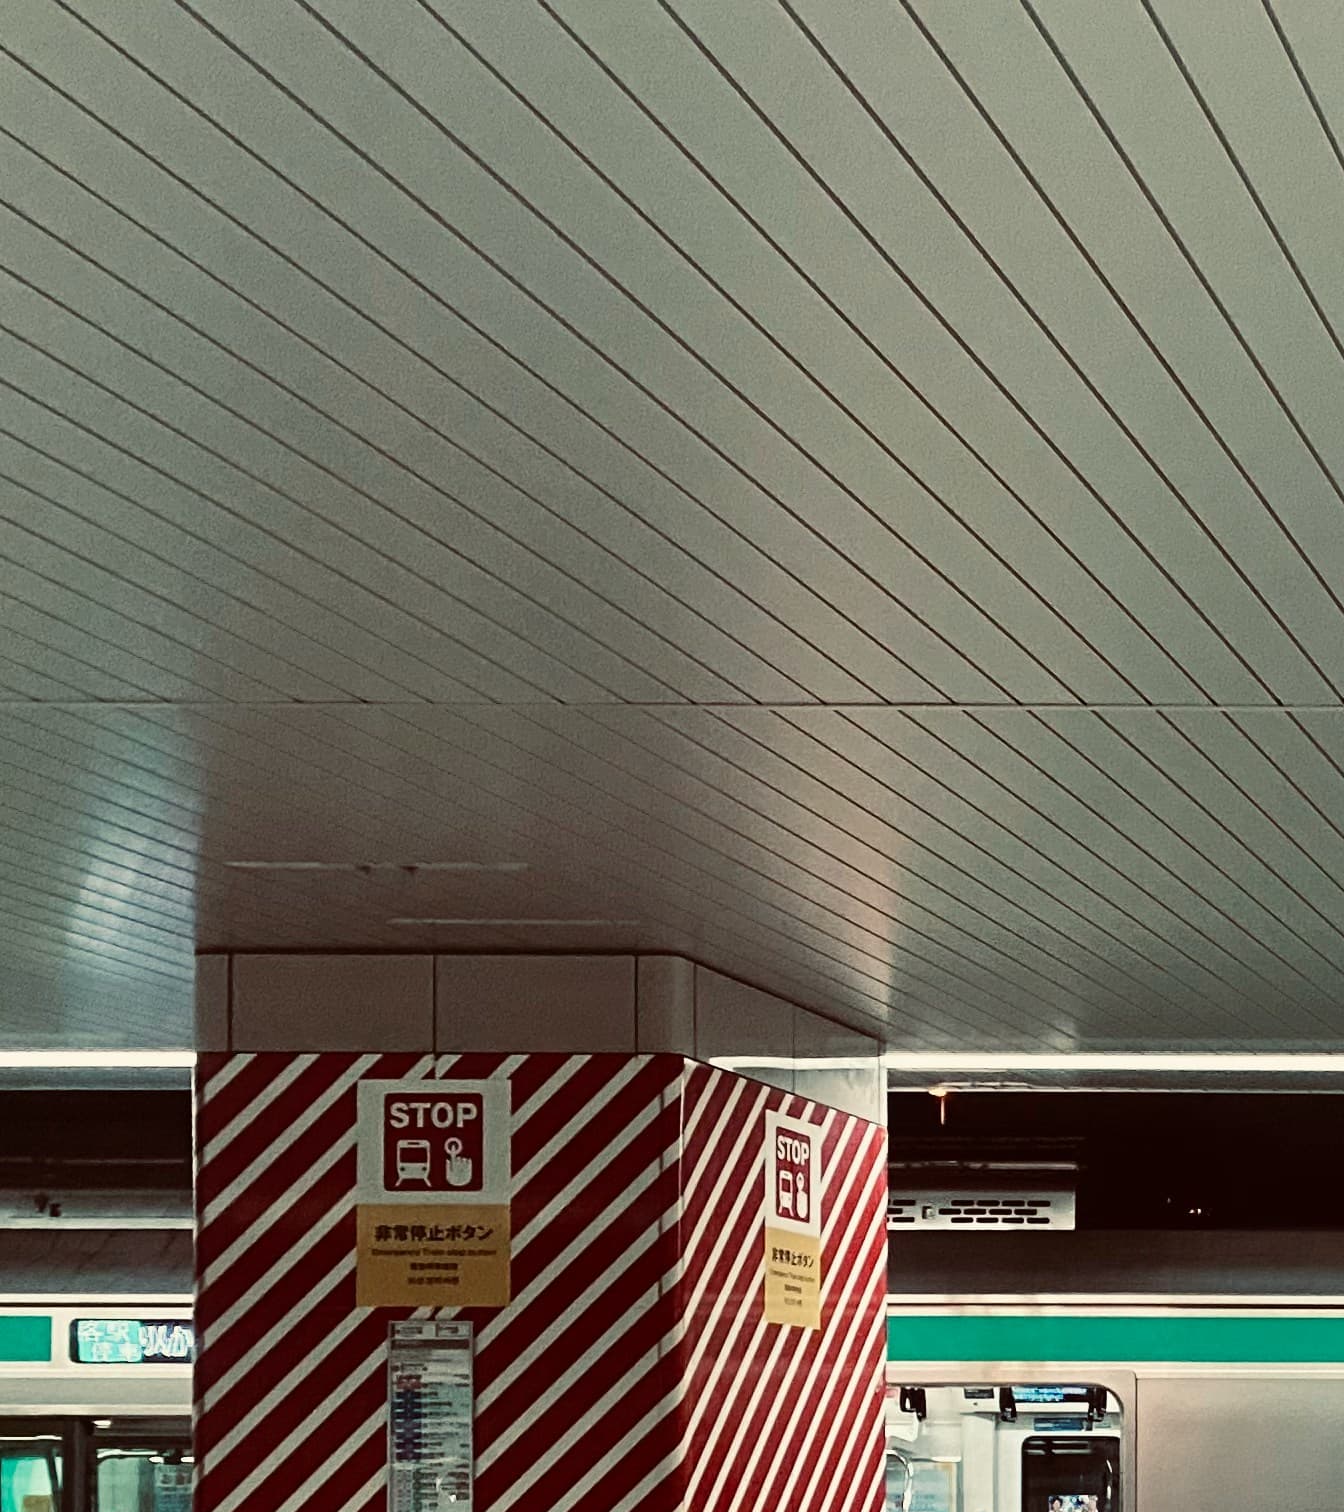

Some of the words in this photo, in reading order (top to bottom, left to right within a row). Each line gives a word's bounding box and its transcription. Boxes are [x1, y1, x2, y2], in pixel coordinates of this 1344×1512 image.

[389, 1102, 478, 1129] STOP
[776, 1134, 810, 1167] STOP
[374, 1224, 494, 1241] 非常停止ボタン
